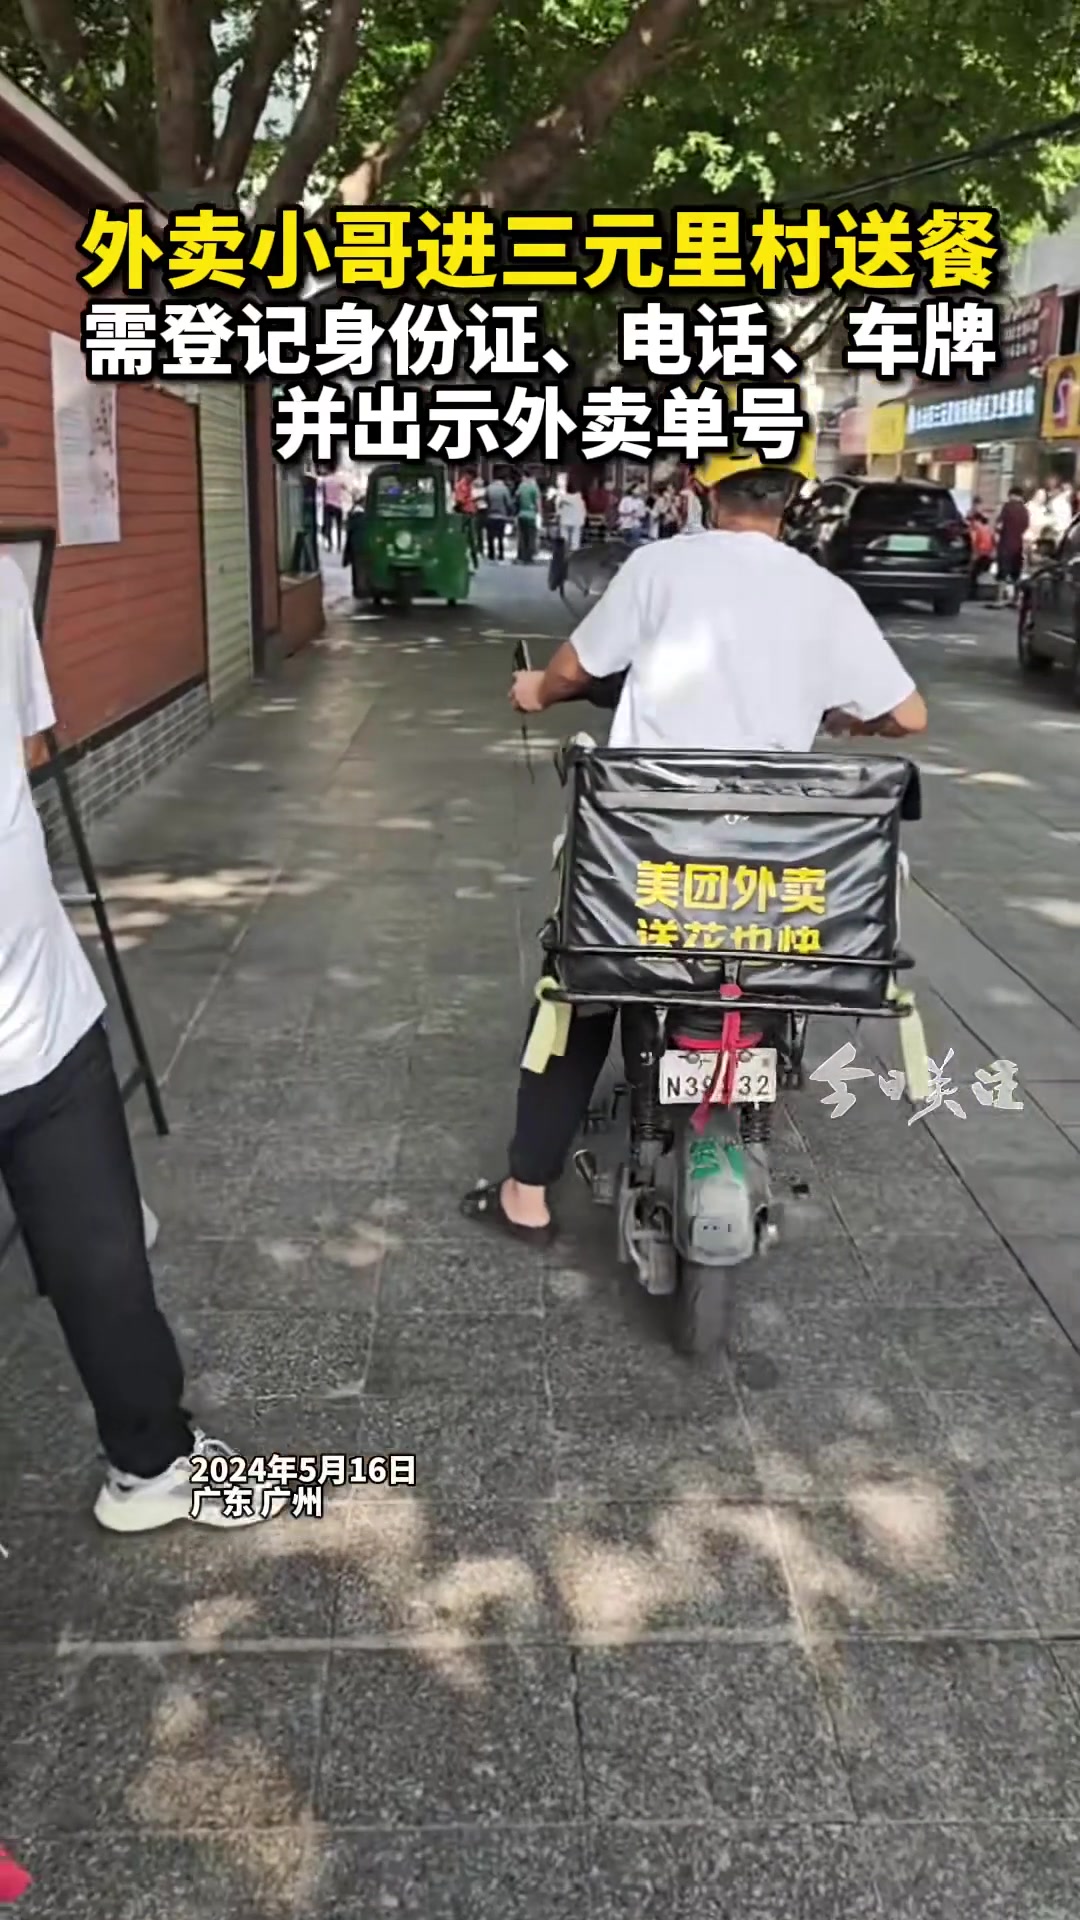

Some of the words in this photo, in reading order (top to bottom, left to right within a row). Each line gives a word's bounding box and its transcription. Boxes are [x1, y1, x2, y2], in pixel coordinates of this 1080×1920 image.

[635, 860, 827, 914] 美团外卖
[667, 1075, 769, 1097] N3932
